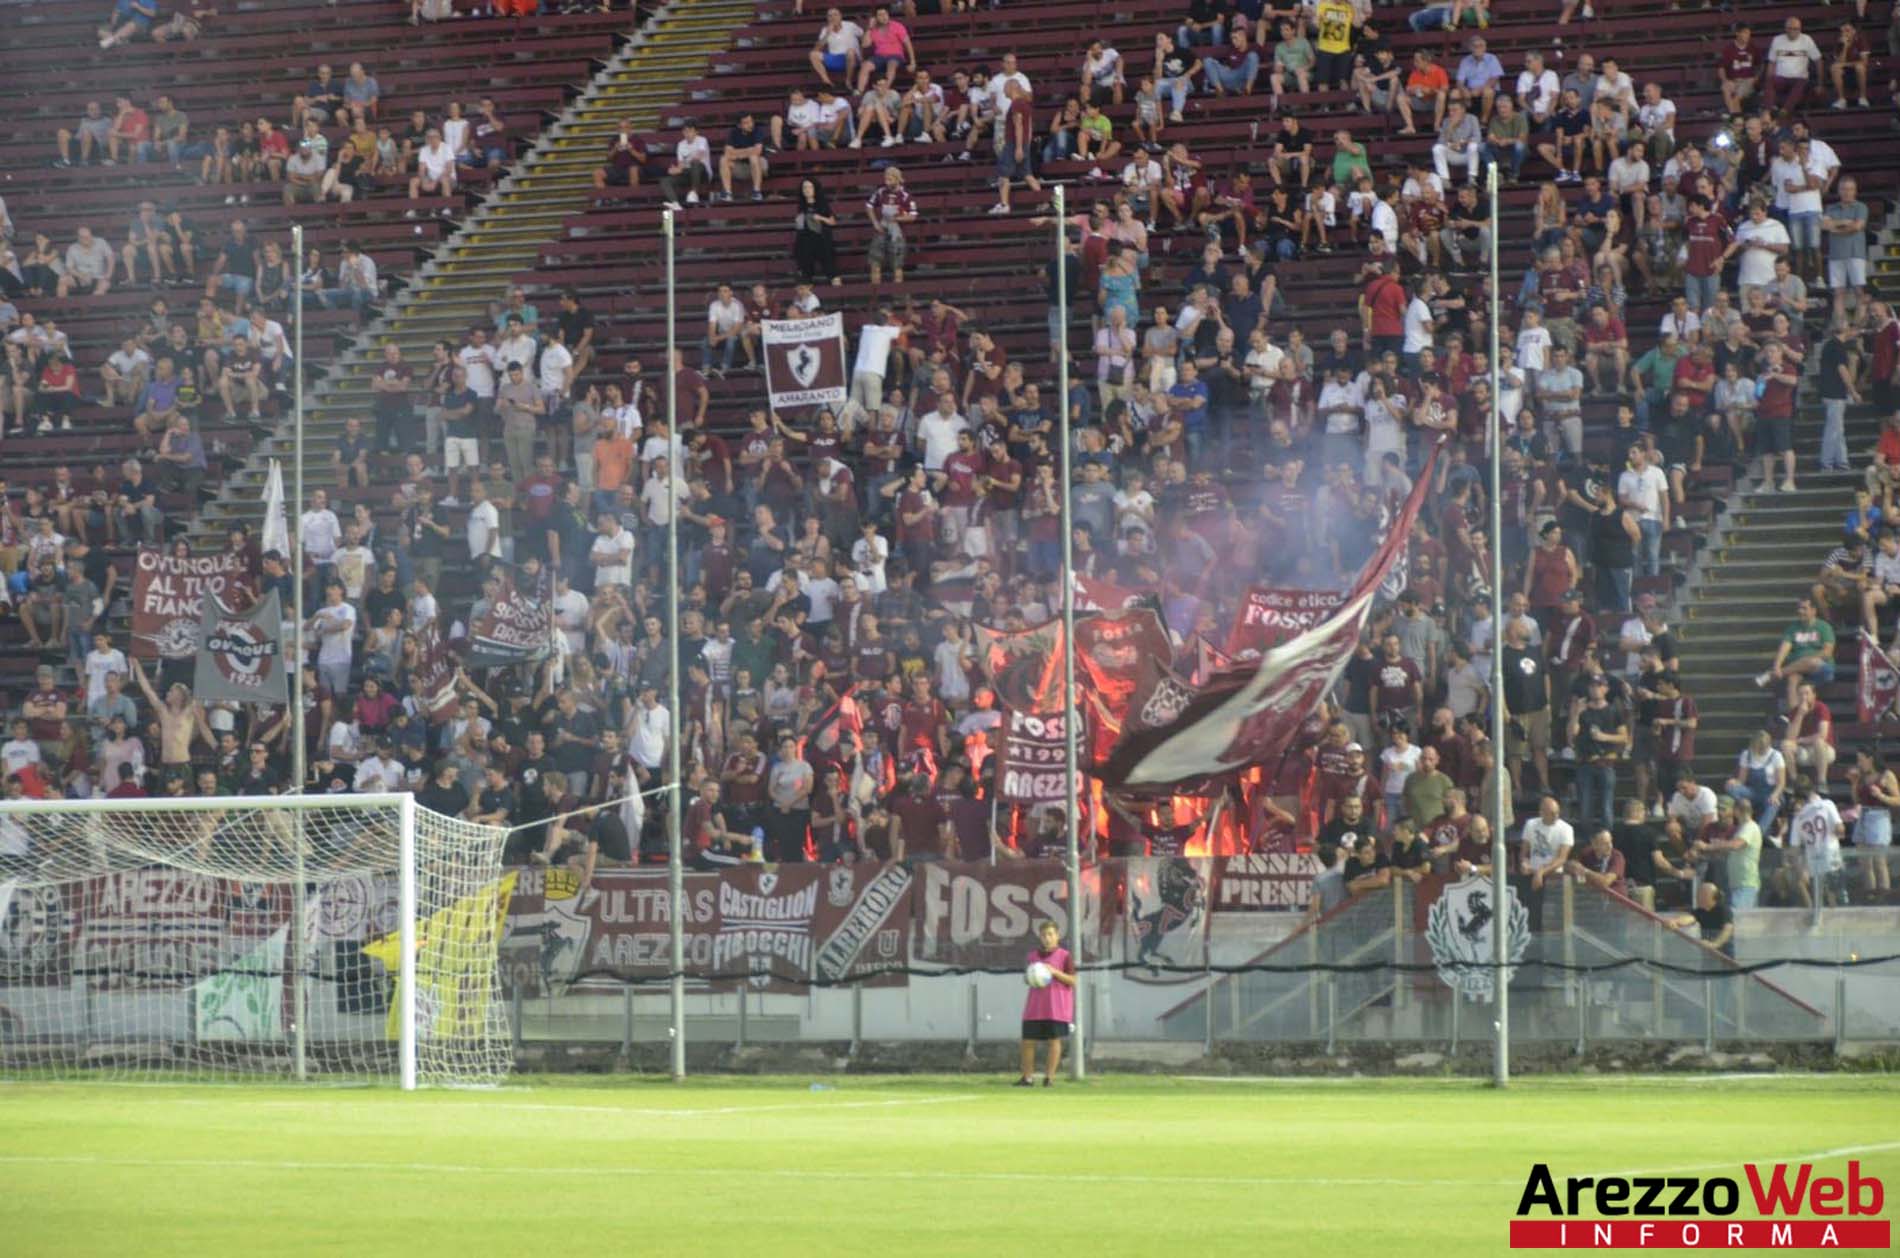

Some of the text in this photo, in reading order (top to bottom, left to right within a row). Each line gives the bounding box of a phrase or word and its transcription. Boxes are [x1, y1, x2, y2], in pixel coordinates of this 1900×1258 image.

[779, 389, 840, 401] AMARANTO
[138, 551, 235, 575] OVUNQUE
[147, 576, 226, 597] AL TUO
[1802, 815, 1828, 846] 39
[600, 888, 716, 923] ULTRAS
[718, 879, 820, 921] CASTIGLION
[591, 932, 713, 966] AREZZO
[713, 930, 811, 972] FIBOCCHI
